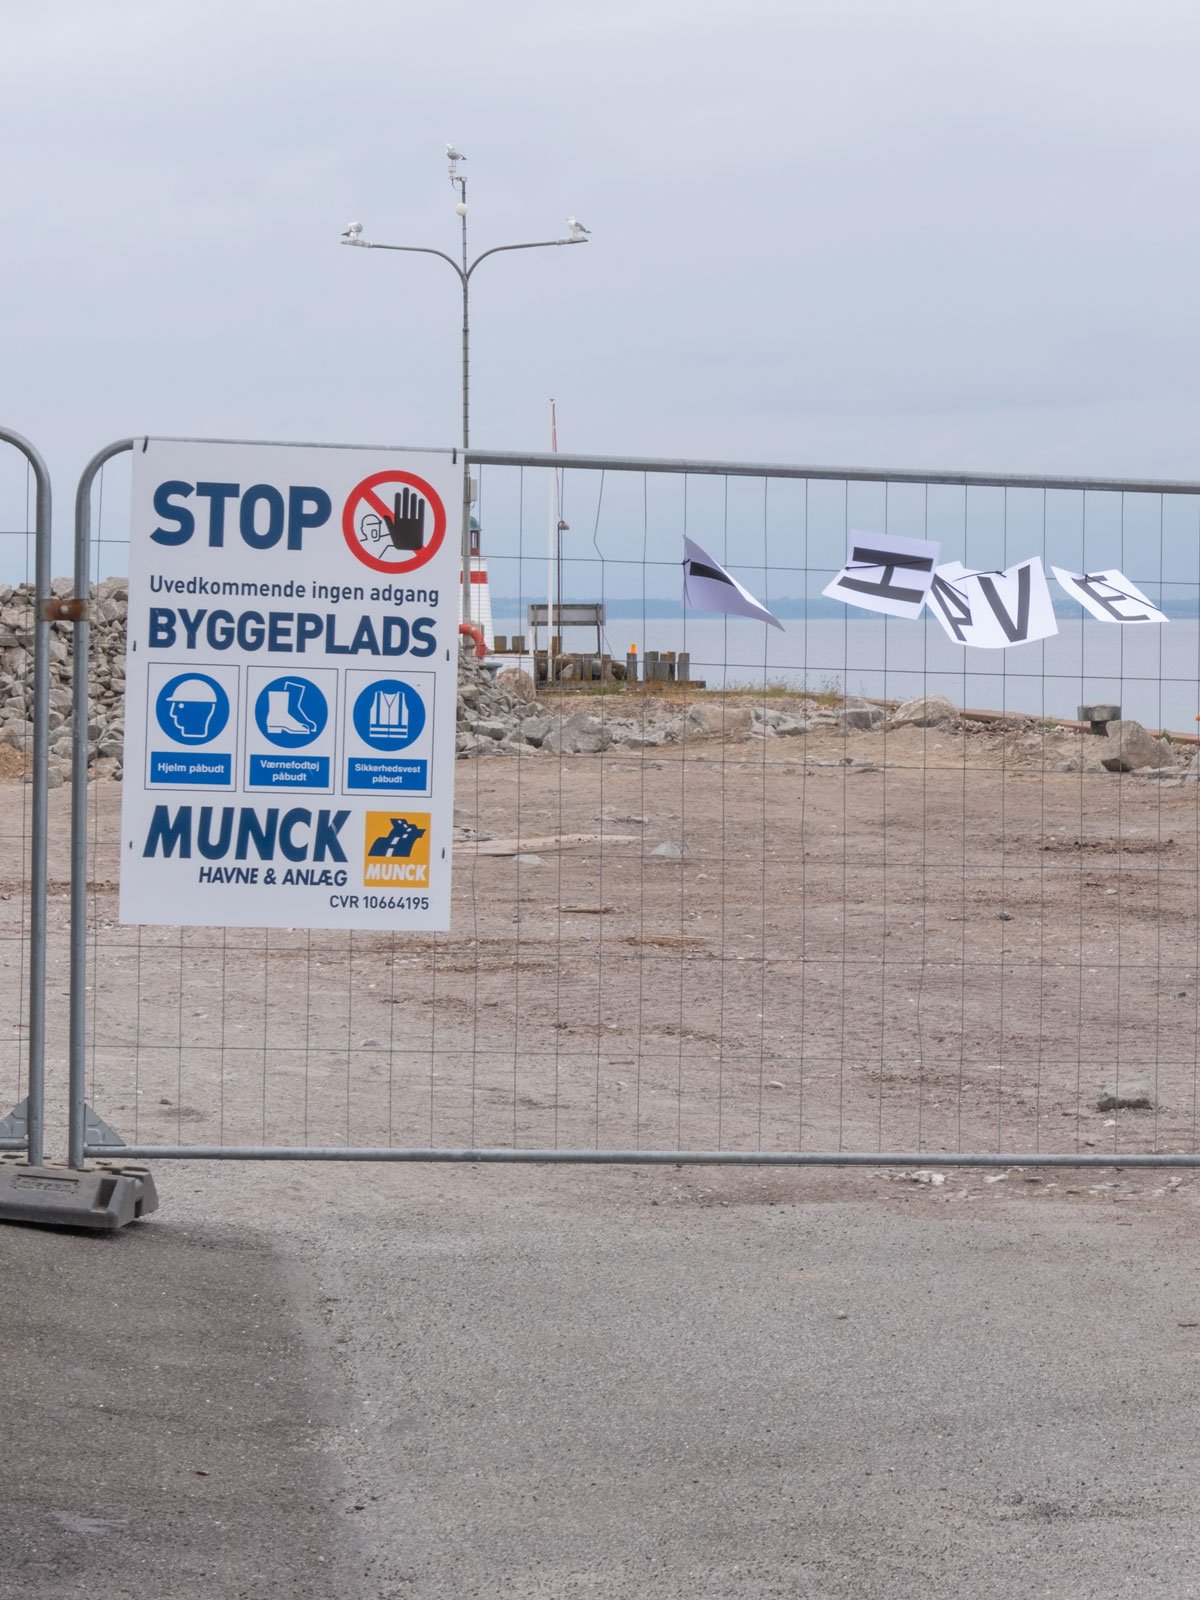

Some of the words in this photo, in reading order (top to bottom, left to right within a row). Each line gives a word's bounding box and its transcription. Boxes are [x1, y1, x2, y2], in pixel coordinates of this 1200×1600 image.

[149, 480, 332, 550] STOP
[150, 574, 306, 599] Uvedkommende
[312, 580, 364, 604] ingen
[370, 583, 440, 608] adgang
[836, 546, 1151, 643] HAVE
[148, 607, 438, 658] BYGGEPLADS
[157, 762, 187, 773] Hjelm
[189, 763, 225, 775] påbudt
[260, 759, 320, 772] Værnefodtøj
[354, 763, 421, 773] Sikkerhedsvest
[272, 771, 308, 783] påbudt
[372, 774, 403, 785] påbudt
[142, 805, 352, 863] MUNCK
[198, 866, 259, 885] HAVNE
[263, 868, 277, 885] &
[282, 868, 348, 887] ANLÆG
[365, 863, 428, 881] MUNCK
[329, 895, 359, 909] CVR
[363, 896, 429, 910] 10664195
